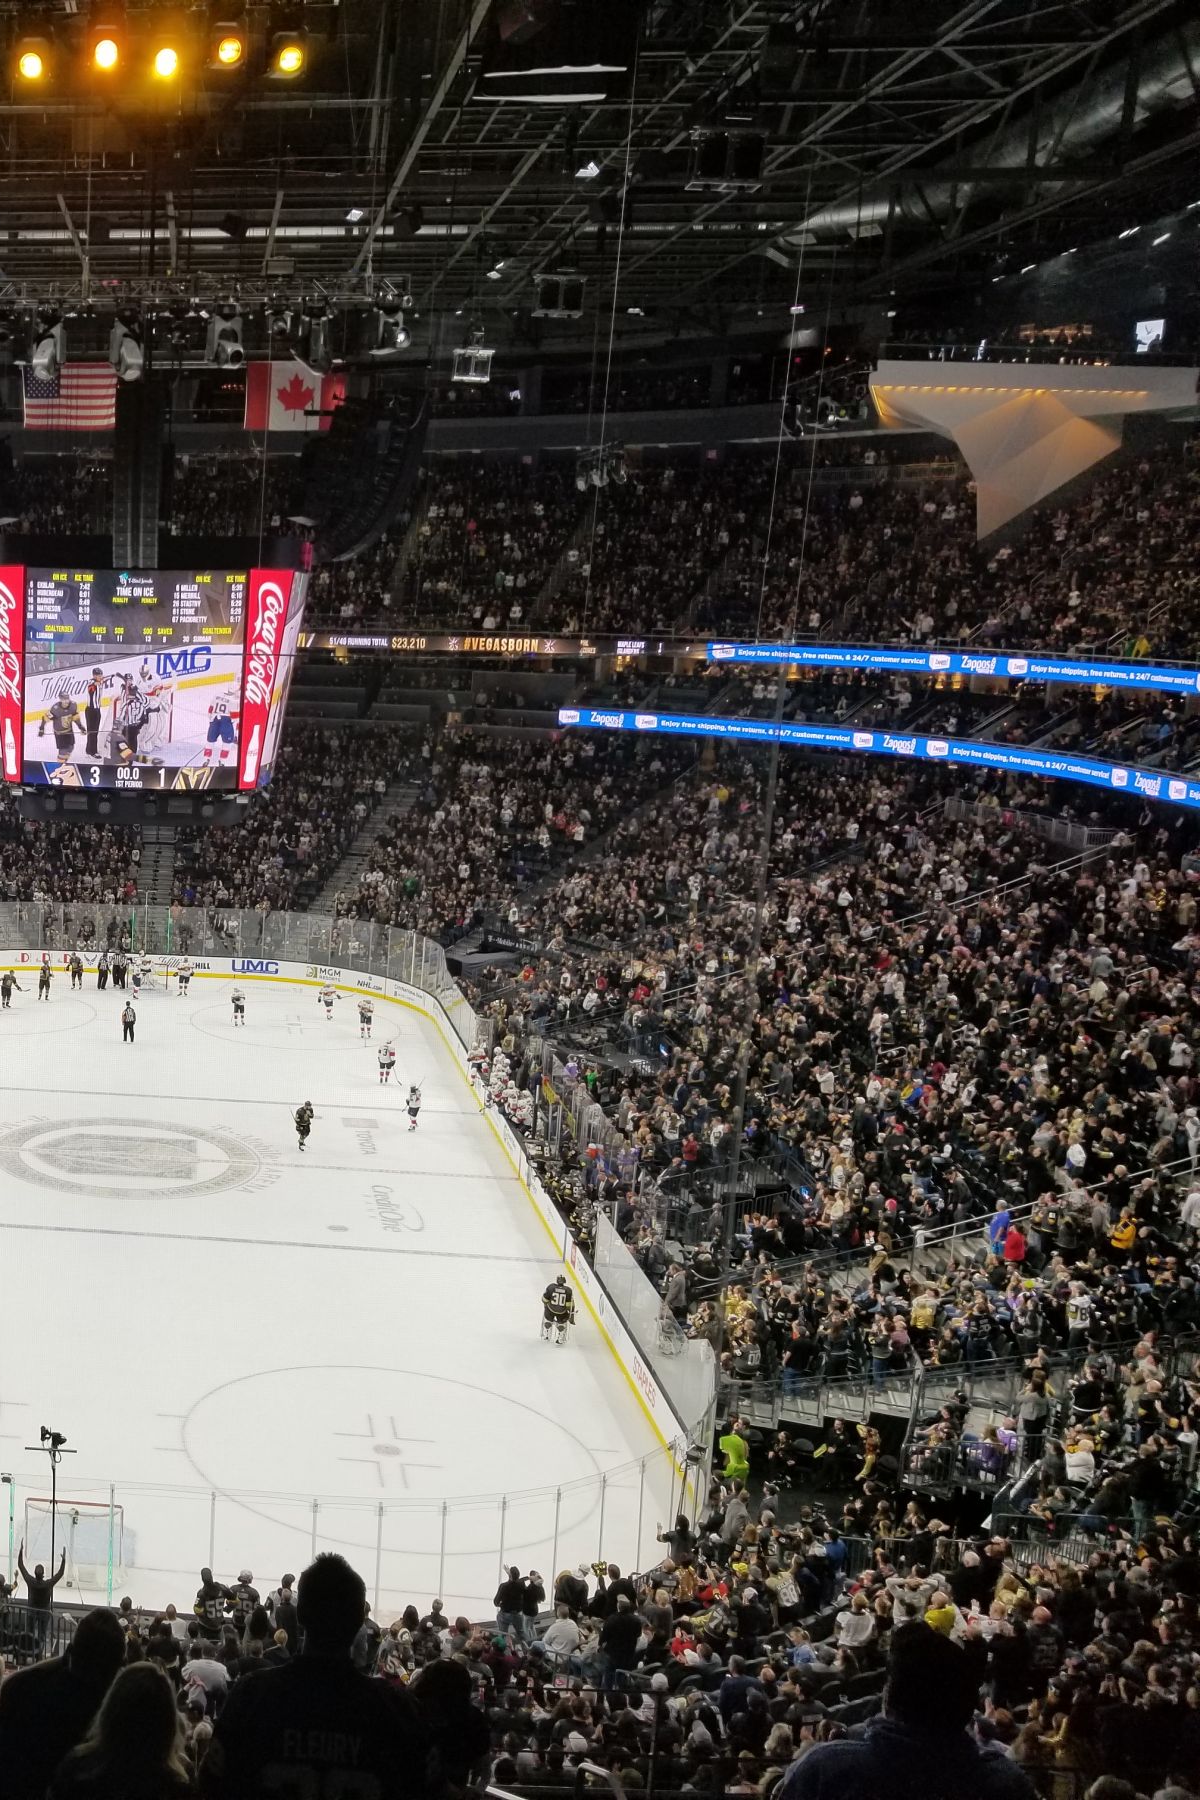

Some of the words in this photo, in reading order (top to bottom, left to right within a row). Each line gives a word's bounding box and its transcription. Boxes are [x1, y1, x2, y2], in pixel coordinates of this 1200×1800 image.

[116, 587, 131, 596] TIME
[133, 587, 142, 596] ON
[143, 587, 154, 597] ICE
[347, 637, 371, 646] RUNNING
[372, 638, 388, 647] TOTAL
[391, 637, 426, 649] $23,210
[464, 637, 538, 652] #VEGASBORN
[738, 648, 756, 656] Enjoy
[1031, 664, 1046, 673] Enjoy
[1061, 667, 1088, 676] shipping,
[1103, 671, 1128, 679] returns,
[1135, 672, 1149, 680] 24/7
[697, 722, 726, 731] shipping,
[792, 731, 824, 739] customer
[90, 766, 100, 786] 3
[117, 768, 139, 779] 00.0
[159, 770, 165, 787] 1
[125, 780, 143, 788] PERIOD
[195, 962, 210, 970] HILL
[232, 959, 279, 974] UMC
[320, 967, 341, 976] MGM
[357, 980, 382, 991] NHL.com
[550, 1292, 567, 1307] 30
[633, 1356, 656, 1408] STAPLES
[283, 1727, 363, 1766] FLEURY
